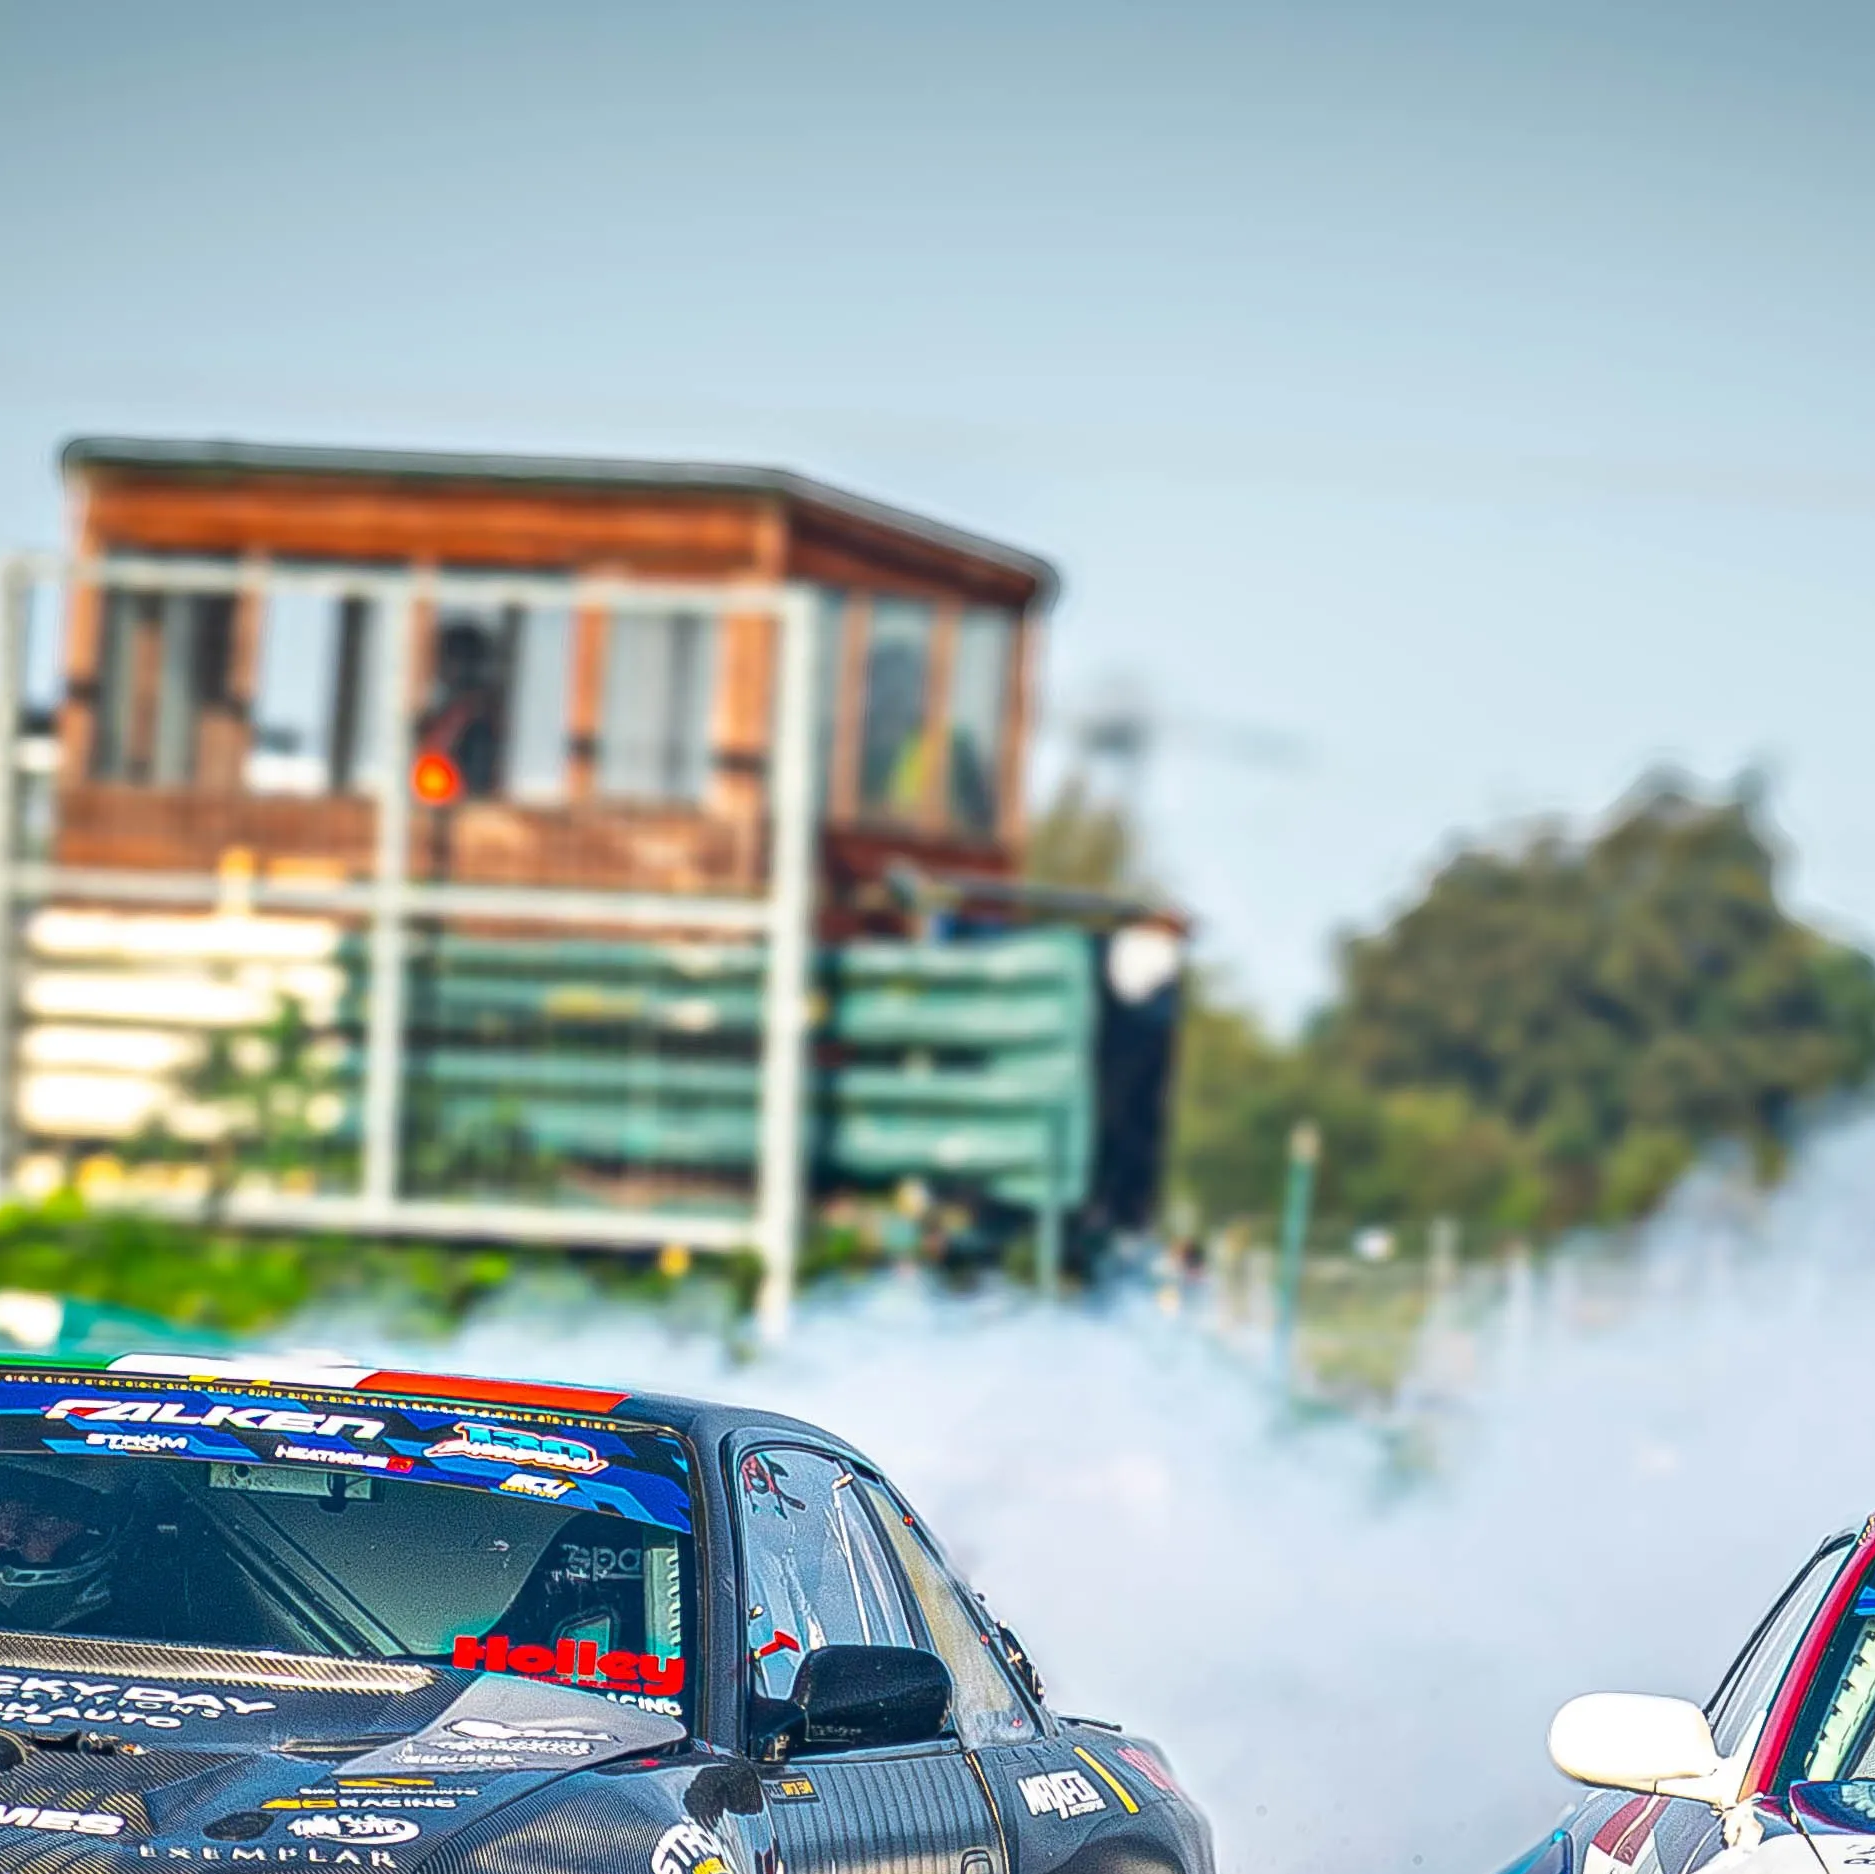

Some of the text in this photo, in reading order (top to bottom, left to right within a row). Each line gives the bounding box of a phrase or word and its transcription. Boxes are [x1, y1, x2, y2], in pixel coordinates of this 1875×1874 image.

[45, 1398, 384, 1440] FALKEN
[451, 1634, 685, 1696] Holley
[122, 1685, 277, 1715] DAY
[53, 1705, 182, 1730] AUTO
[339, 1797, 457, 1809] RACING
[138, 1844, 398, 1869] EXEMPLAR
